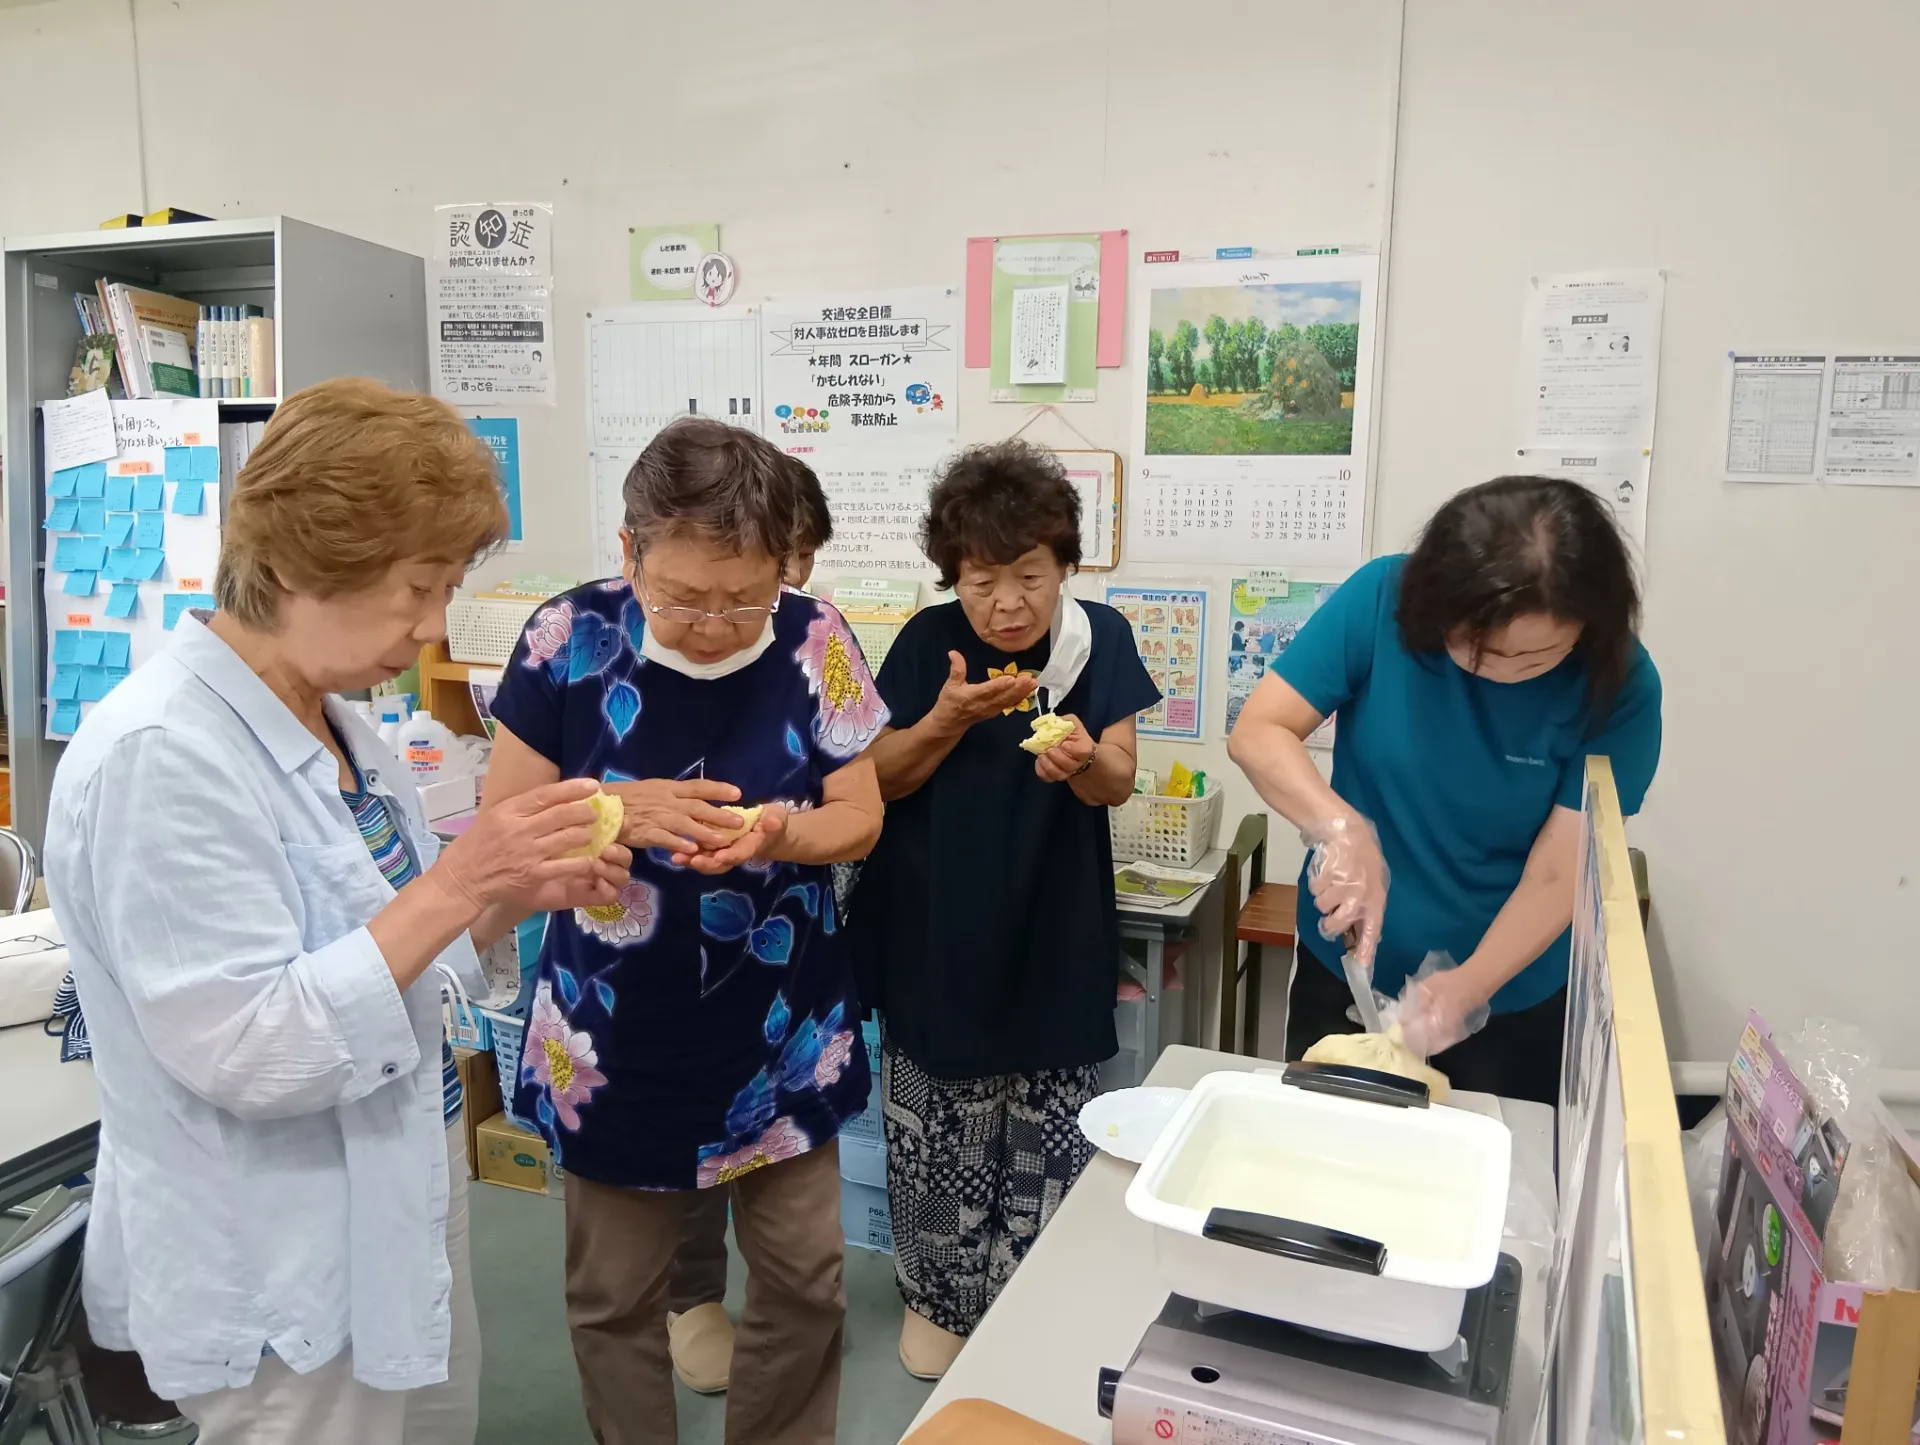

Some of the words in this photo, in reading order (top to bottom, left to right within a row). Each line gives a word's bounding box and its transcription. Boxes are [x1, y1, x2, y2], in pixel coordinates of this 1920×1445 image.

[822, 305, 892, 321] 交通安全目標
[794, 324, 921, 340] 対人事故ゼロを目指します
[811, 374, 886, 388] 「かもしれない」
[828, 393, 896, 408] 危険予知から
[113, 414, 160, 432] の「困りごと」
[851, 413, 898, 427] 事故防止
[1142, 468, 1150, 480] 9
[1339, 469, 1351, 481] 10
[1160, 487, 1163, 496] 1
[1172, 488, 1177, 496] 2
[1186, 488, 1191, 496] 3
[1297, 489, 1301, 497] 1
[1326, 490, 1331, 498] 3
[1184, 499, 1192, 507] 10
[1198, 499, 1205, 507] 11
[1211, 499, 1219, 507] 12
[1310, 500, 1316, 508] 9
[1324, 500, 1332, 508] 10
[1338, 500, 1346, 508] 11
[1170, 509, 1178, 517] 16
[1184, 509, 1192, 517] 17
[1197, 509, 1205, 517] 18
[1211, 509, 1219, 517] 19
[1224, 510, 1233, 518] 20
[1252, 510, 1260, 518] 12
[1308, 511, 1317, 519] 16
[1323, 511, 1332, 519] 17
[1156, 519, 1164, 527] 22
[1196, 520, 1205, 528] 25
[1224, 520, 1232, 528] 27
[1252, 521, 1260, 529] 19
[1265, 521, 1274, 529] 20
[1279, 521, 1288, 529] 21
[1293, 521, 1302, 529] 22
[1322, 522, 1331, 530] 24
[1336, 522, 1346, 530] 25
[1156, 529, 1164, 537] 29
[1264, 532, 1273, 540] 27
[1293, 532, 1302, 540] 29
[1307, 532, 1316, 540] 30
[1322, 532, 1330, 541] 31
